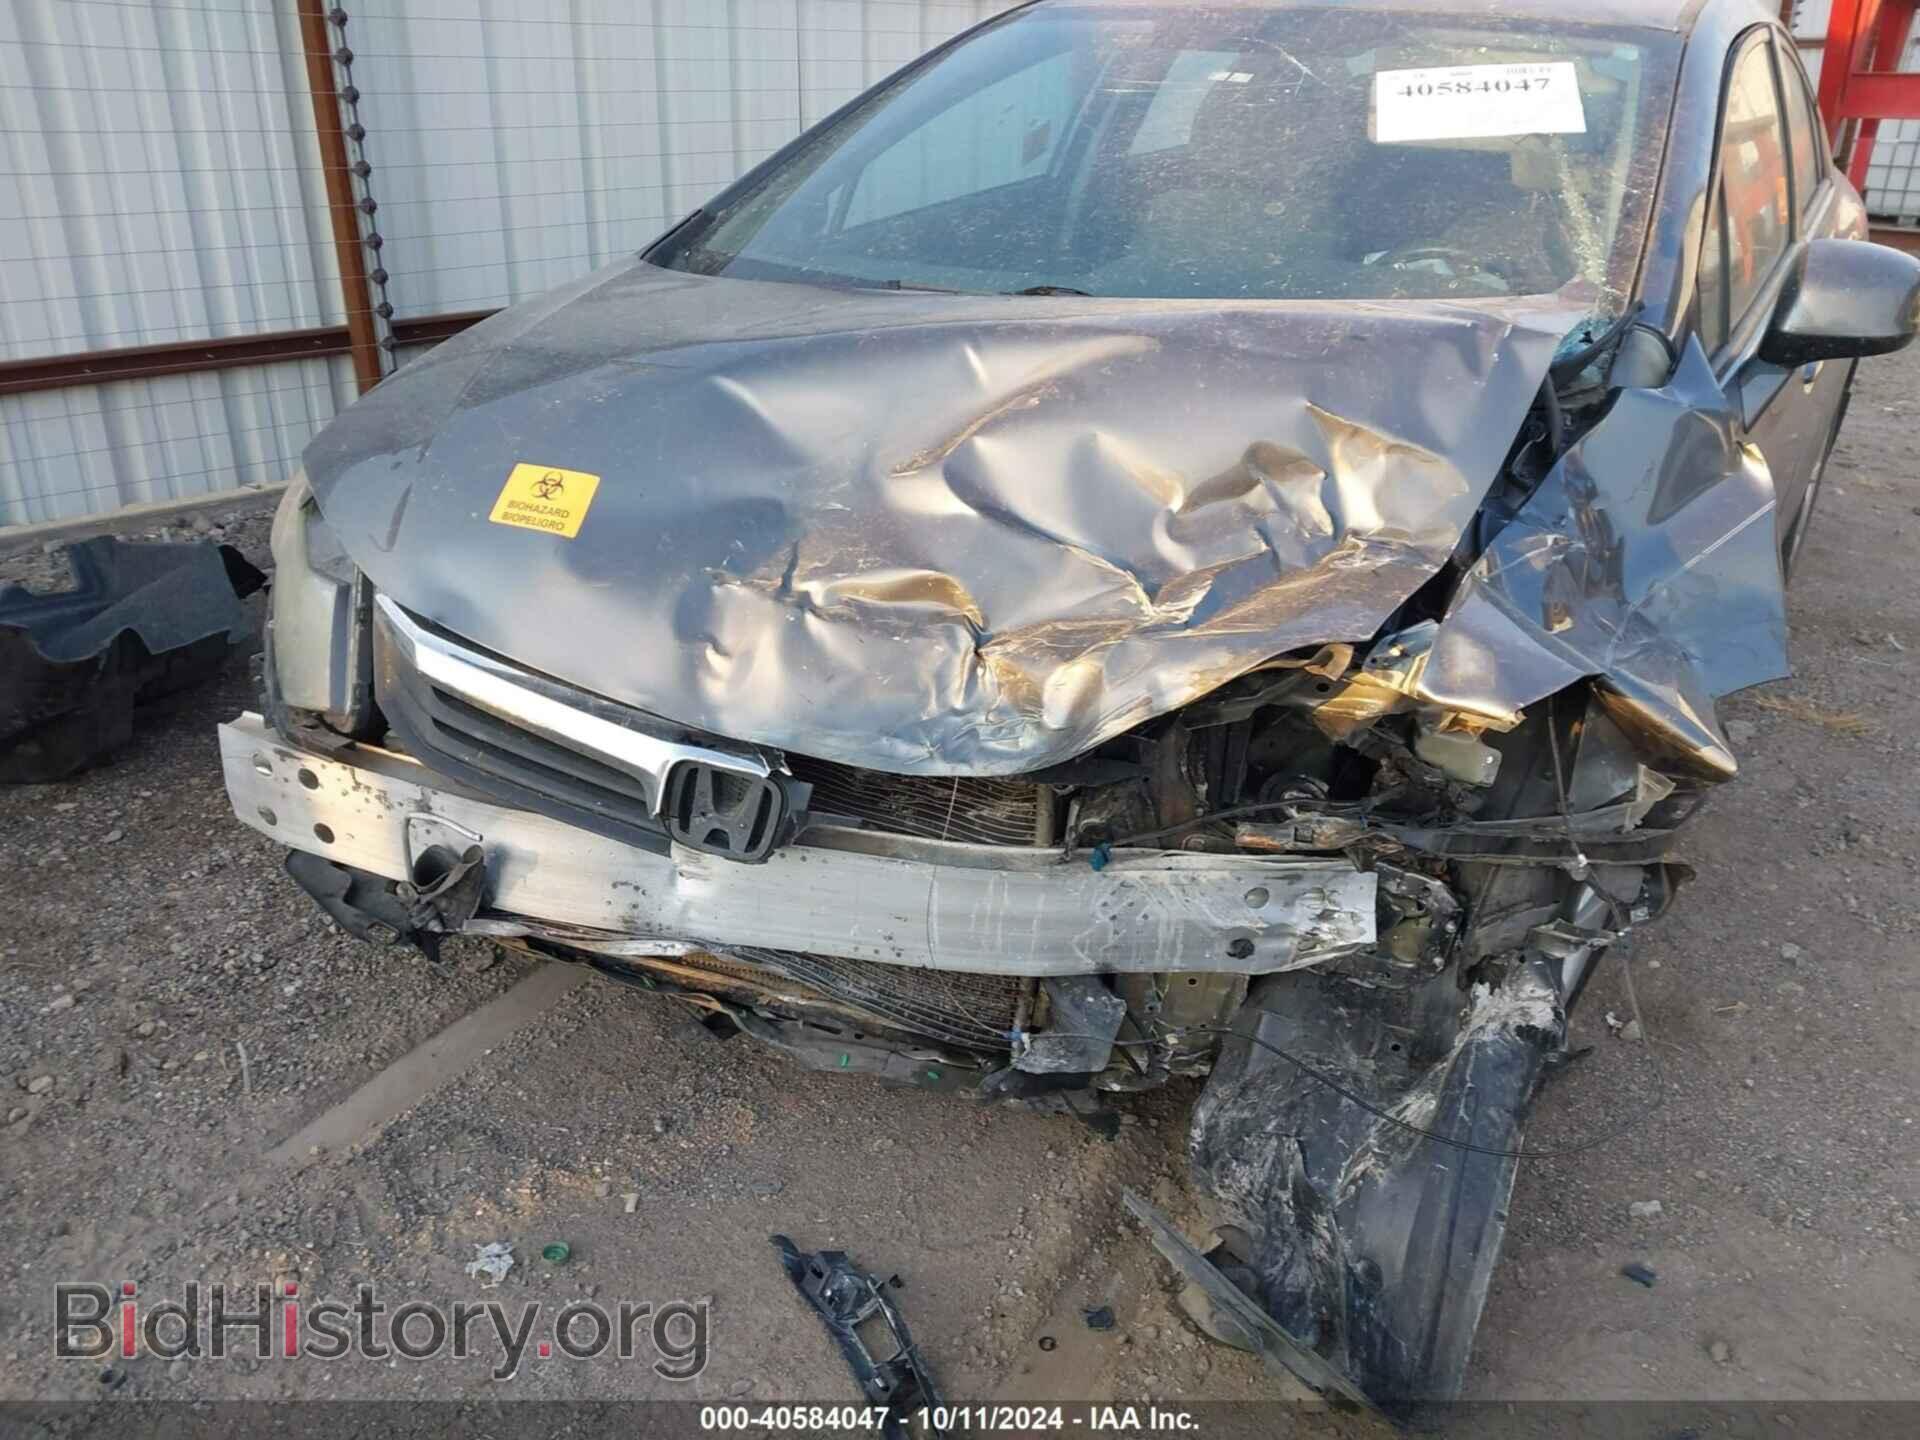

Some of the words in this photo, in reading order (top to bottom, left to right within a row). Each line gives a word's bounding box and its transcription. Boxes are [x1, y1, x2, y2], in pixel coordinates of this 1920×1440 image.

[1397, 77, 1551, 98] 40584047
[507, 500, 570, 519] BIOHAZARD
[501, 511, 565, 531] BIOPELIGRO
